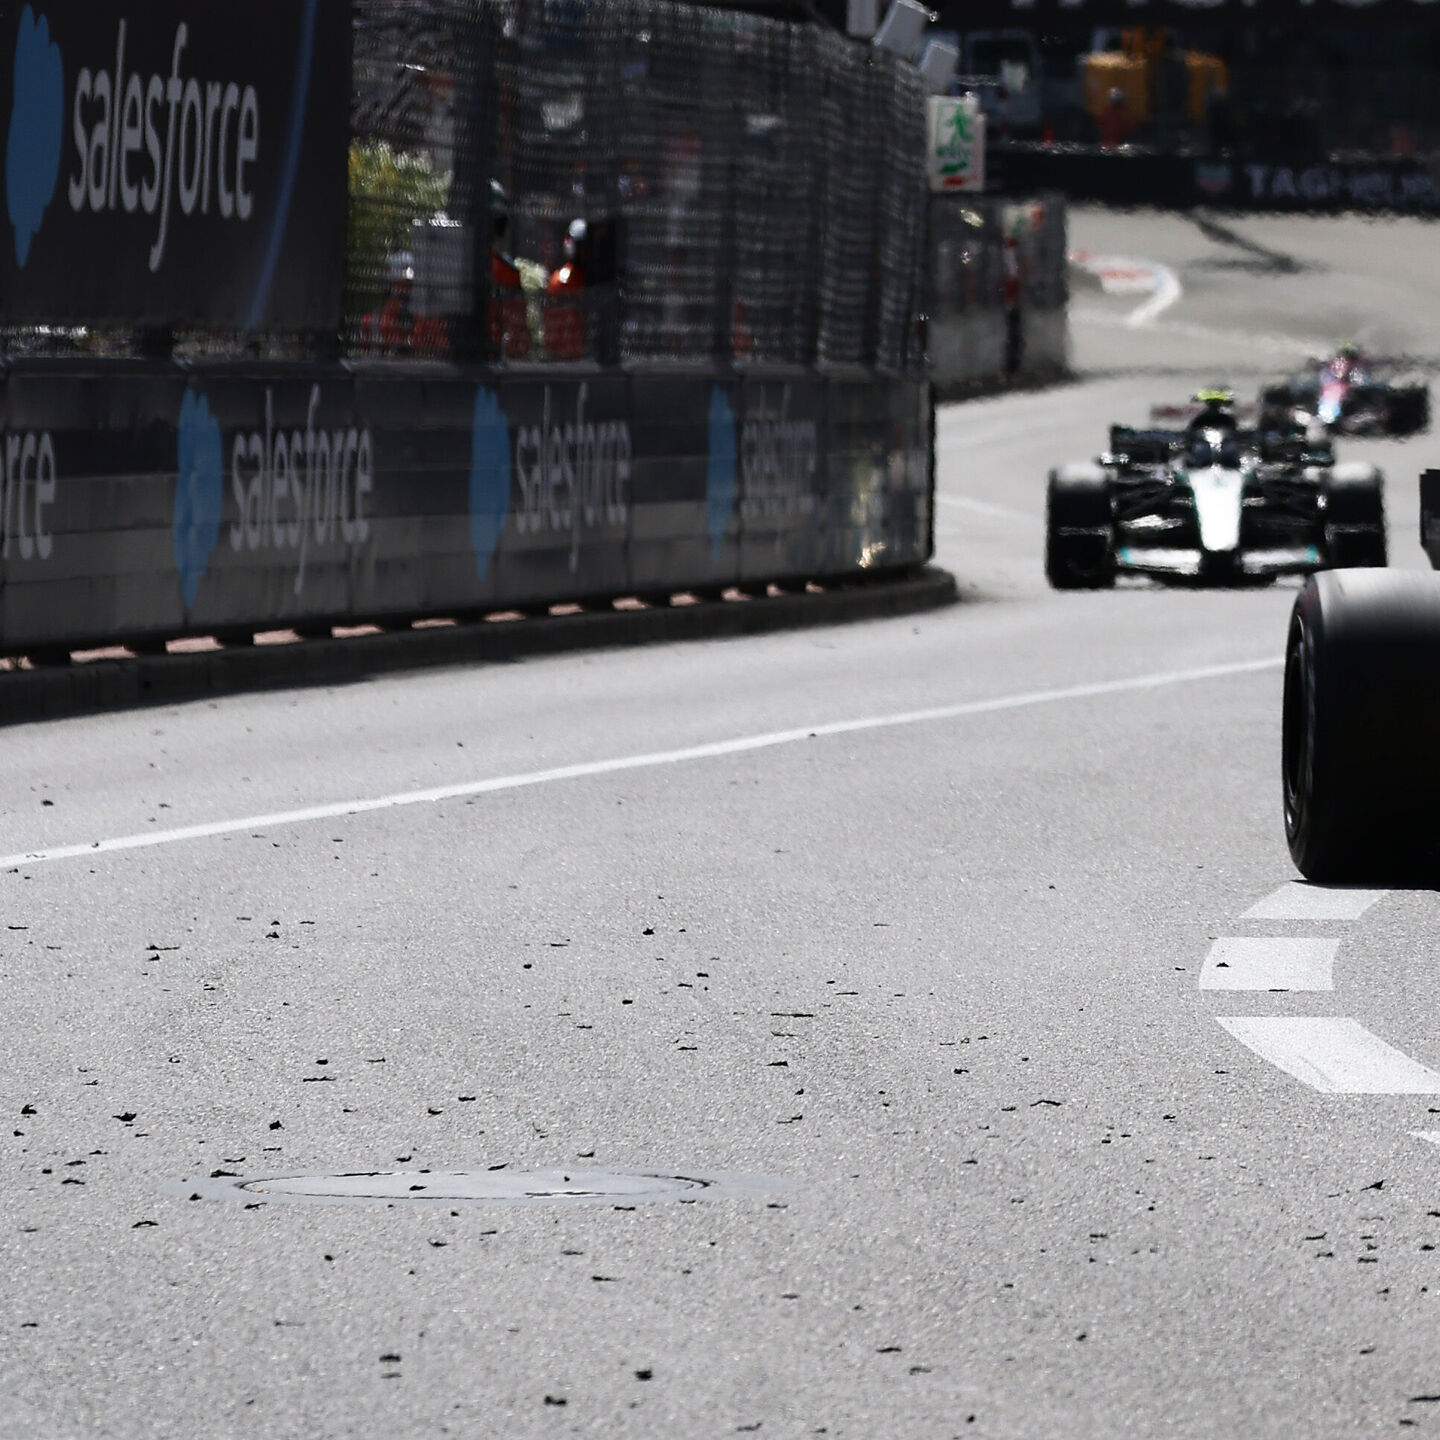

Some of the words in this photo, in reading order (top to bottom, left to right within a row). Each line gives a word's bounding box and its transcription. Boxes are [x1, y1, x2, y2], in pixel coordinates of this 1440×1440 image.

[68, 17, 259, 272] salesforce
[230, 382, 373, 595] salesforce
[516, 382, 632, 572] salesforce
